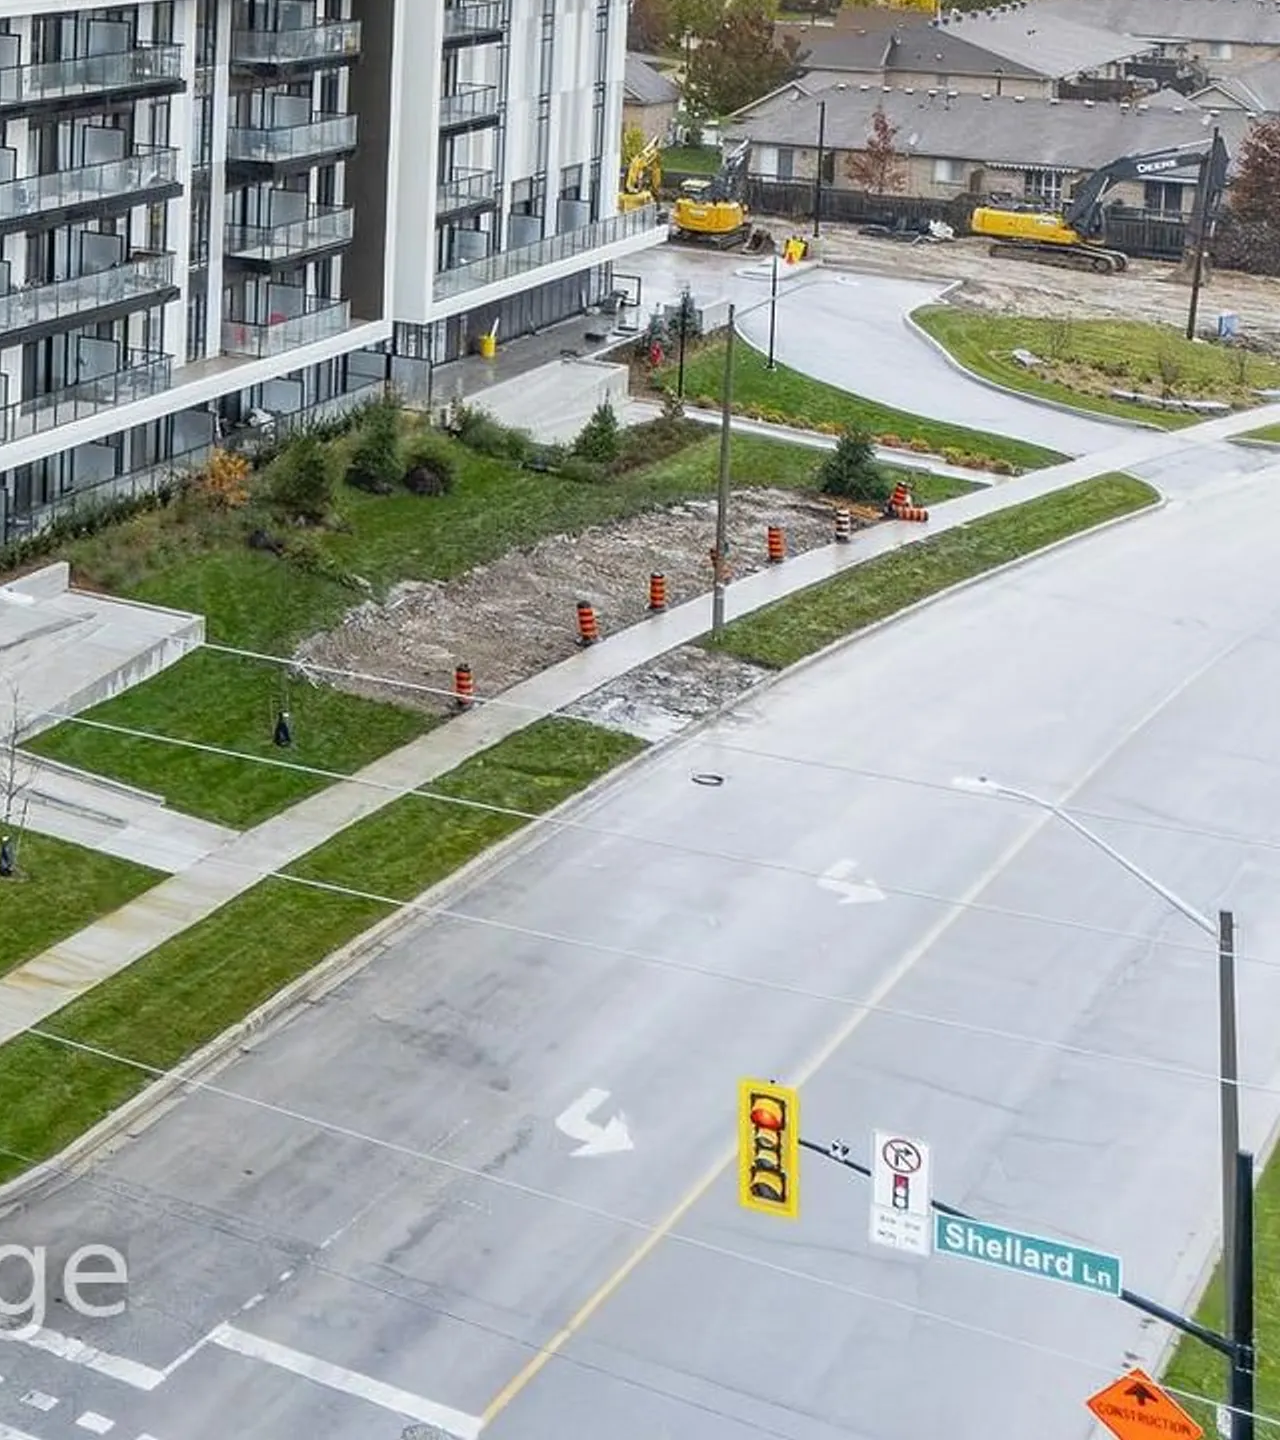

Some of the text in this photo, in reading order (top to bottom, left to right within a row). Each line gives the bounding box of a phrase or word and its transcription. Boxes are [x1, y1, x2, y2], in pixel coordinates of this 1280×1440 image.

[944, 1223, 1112, 1288] Shellard Ln
[1096, 1401, 1192, 1435] CONSTRUCTION
